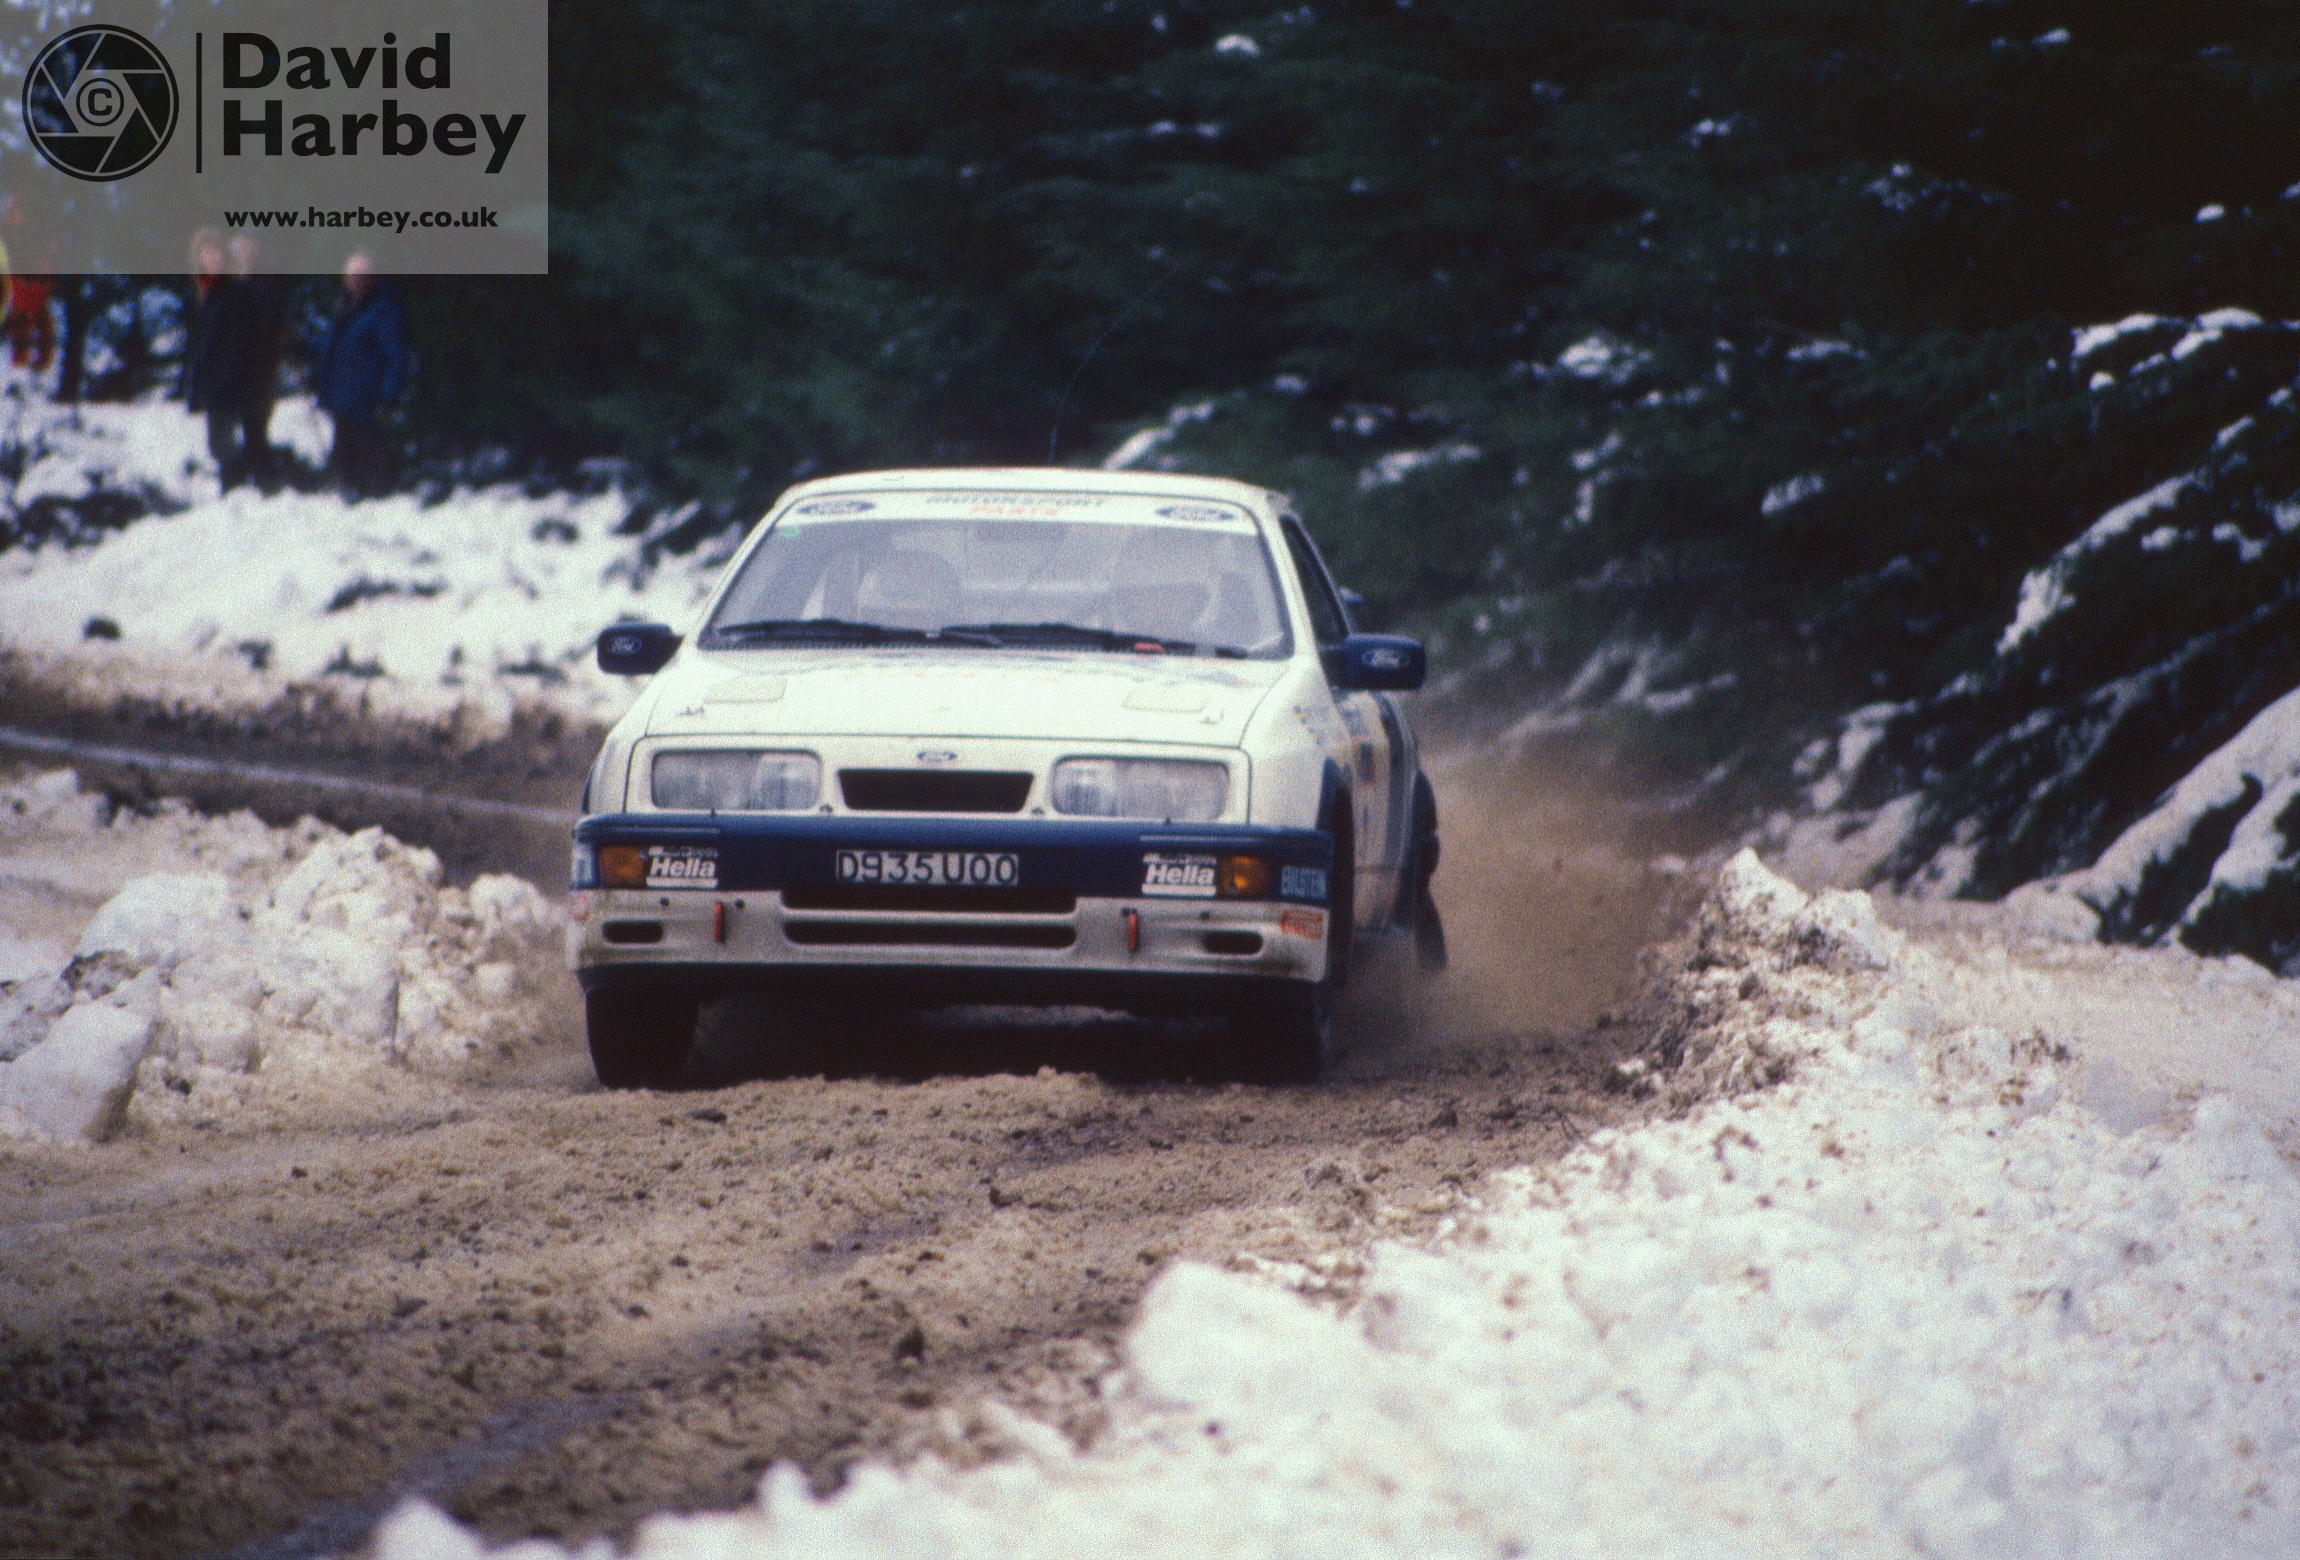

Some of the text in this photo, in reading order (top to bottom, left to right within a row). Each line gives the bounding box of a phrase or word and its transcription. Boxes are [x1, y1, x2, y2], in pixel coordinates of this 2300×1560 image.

[649, 856, 717, 878] Hella
[838, 851, 933, 883] D935
[1144, 863, 1215, 886] Hella
